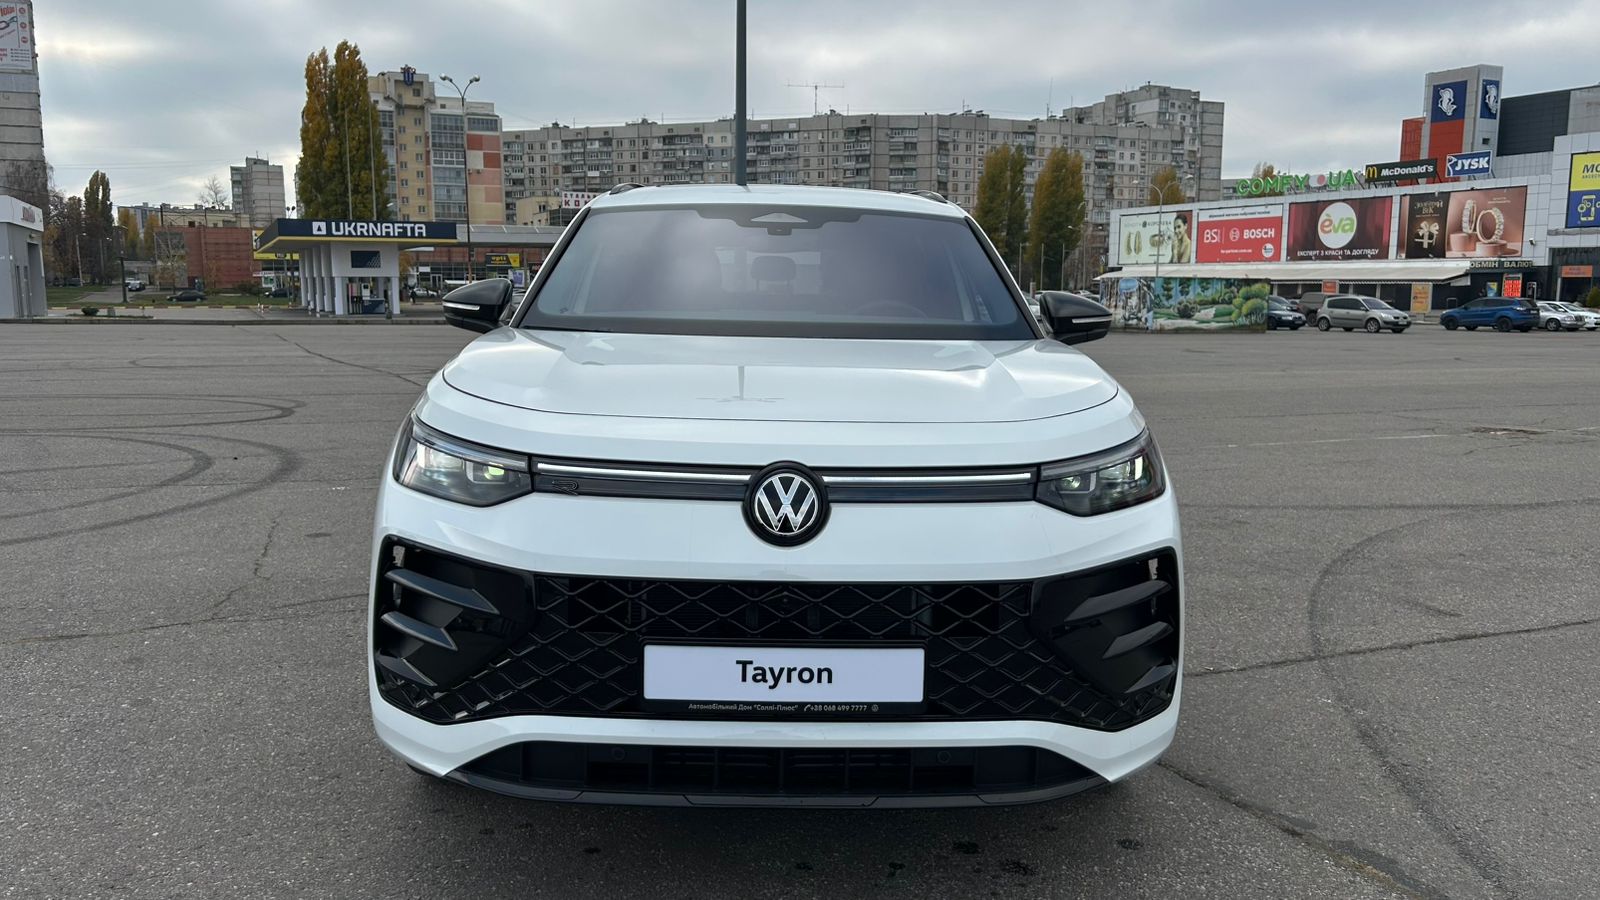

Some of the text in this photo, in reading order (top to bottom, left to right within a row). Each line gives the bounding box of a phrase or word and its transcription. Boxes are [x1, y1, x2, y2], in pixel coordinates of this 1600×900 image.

[1380, 164, 1434, 177] McDonald's
[1454, 157, 1489, 171] JYSK
[1236, 168, 1357, 196] COMFY UA
[331, 221, 426, 237] UKRNAFTA
[1243, 228, 1275, 239] BOSCH
[1352, 248, 1379, 256] ДОГЛЯДУ
[736, 660, 833, 689] Tayron
[688, 703, 738, 711] Автомобільний
